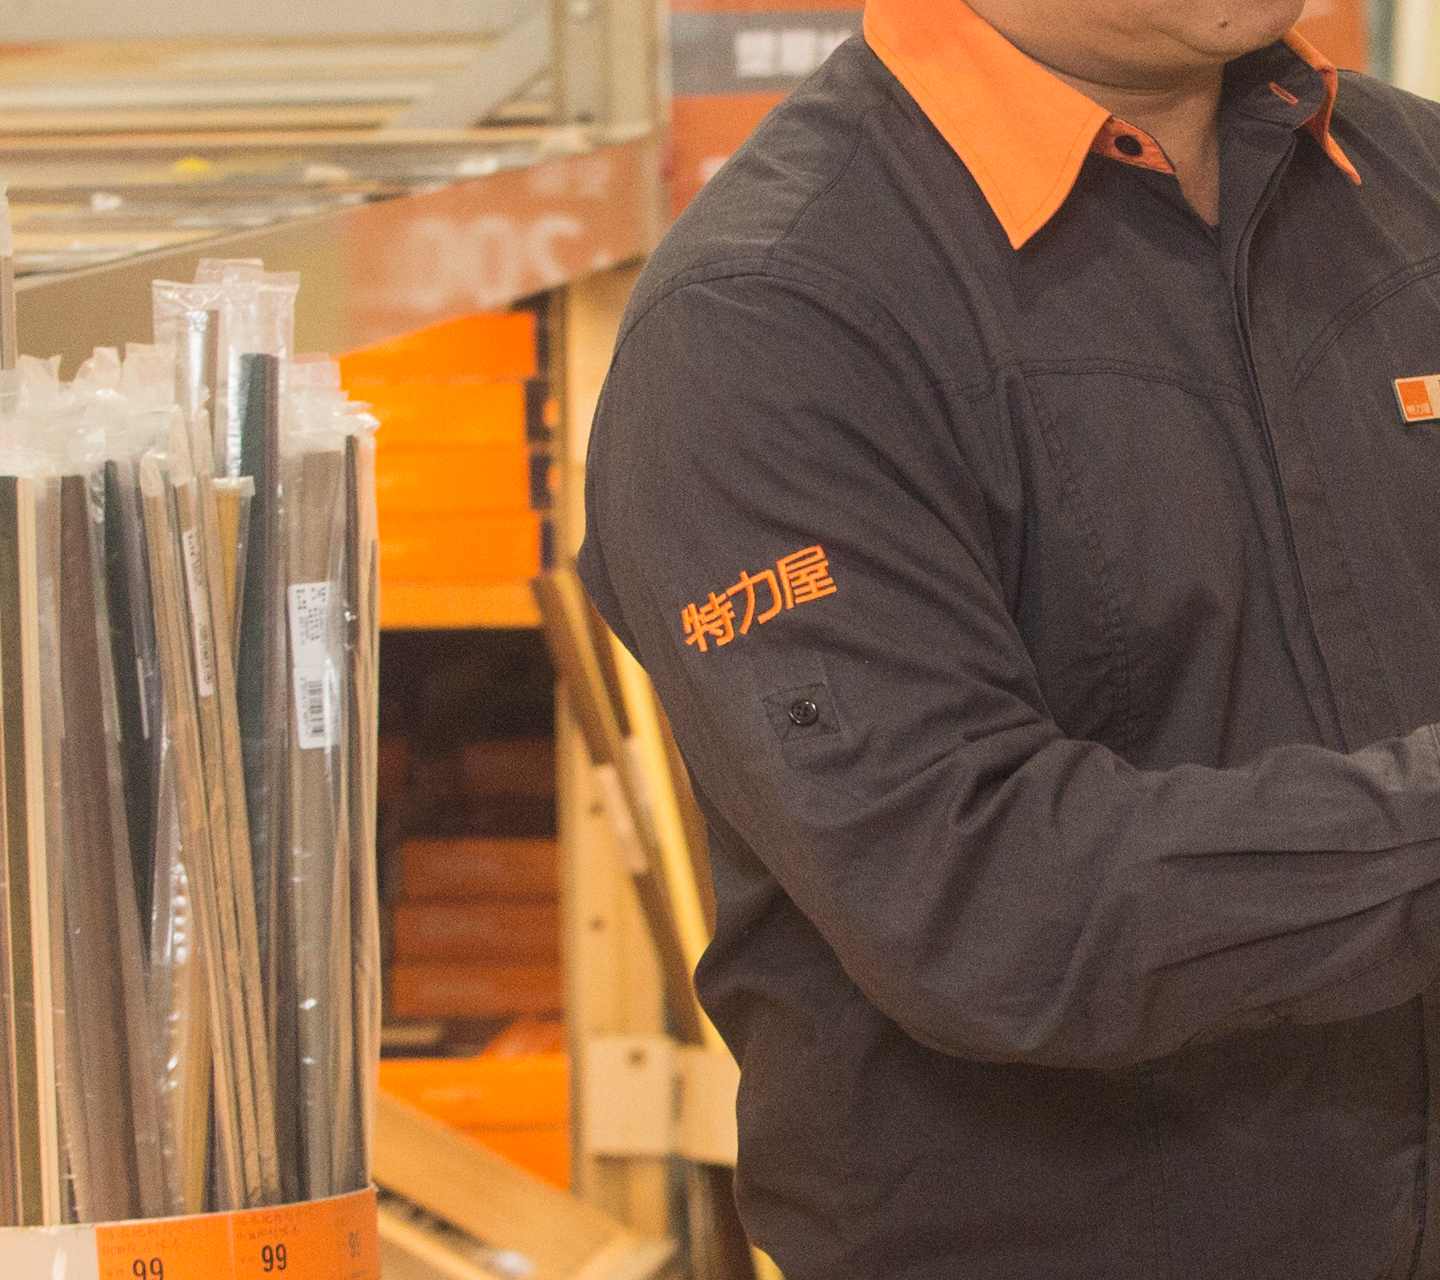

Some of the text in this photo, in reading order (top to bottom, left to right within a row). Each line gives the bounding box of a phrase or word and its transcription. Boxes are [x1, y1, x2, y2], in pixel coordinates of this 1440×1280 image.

[681, 544, 837, 653] 特力屋
[261, 1243, 288, 1272] 99
